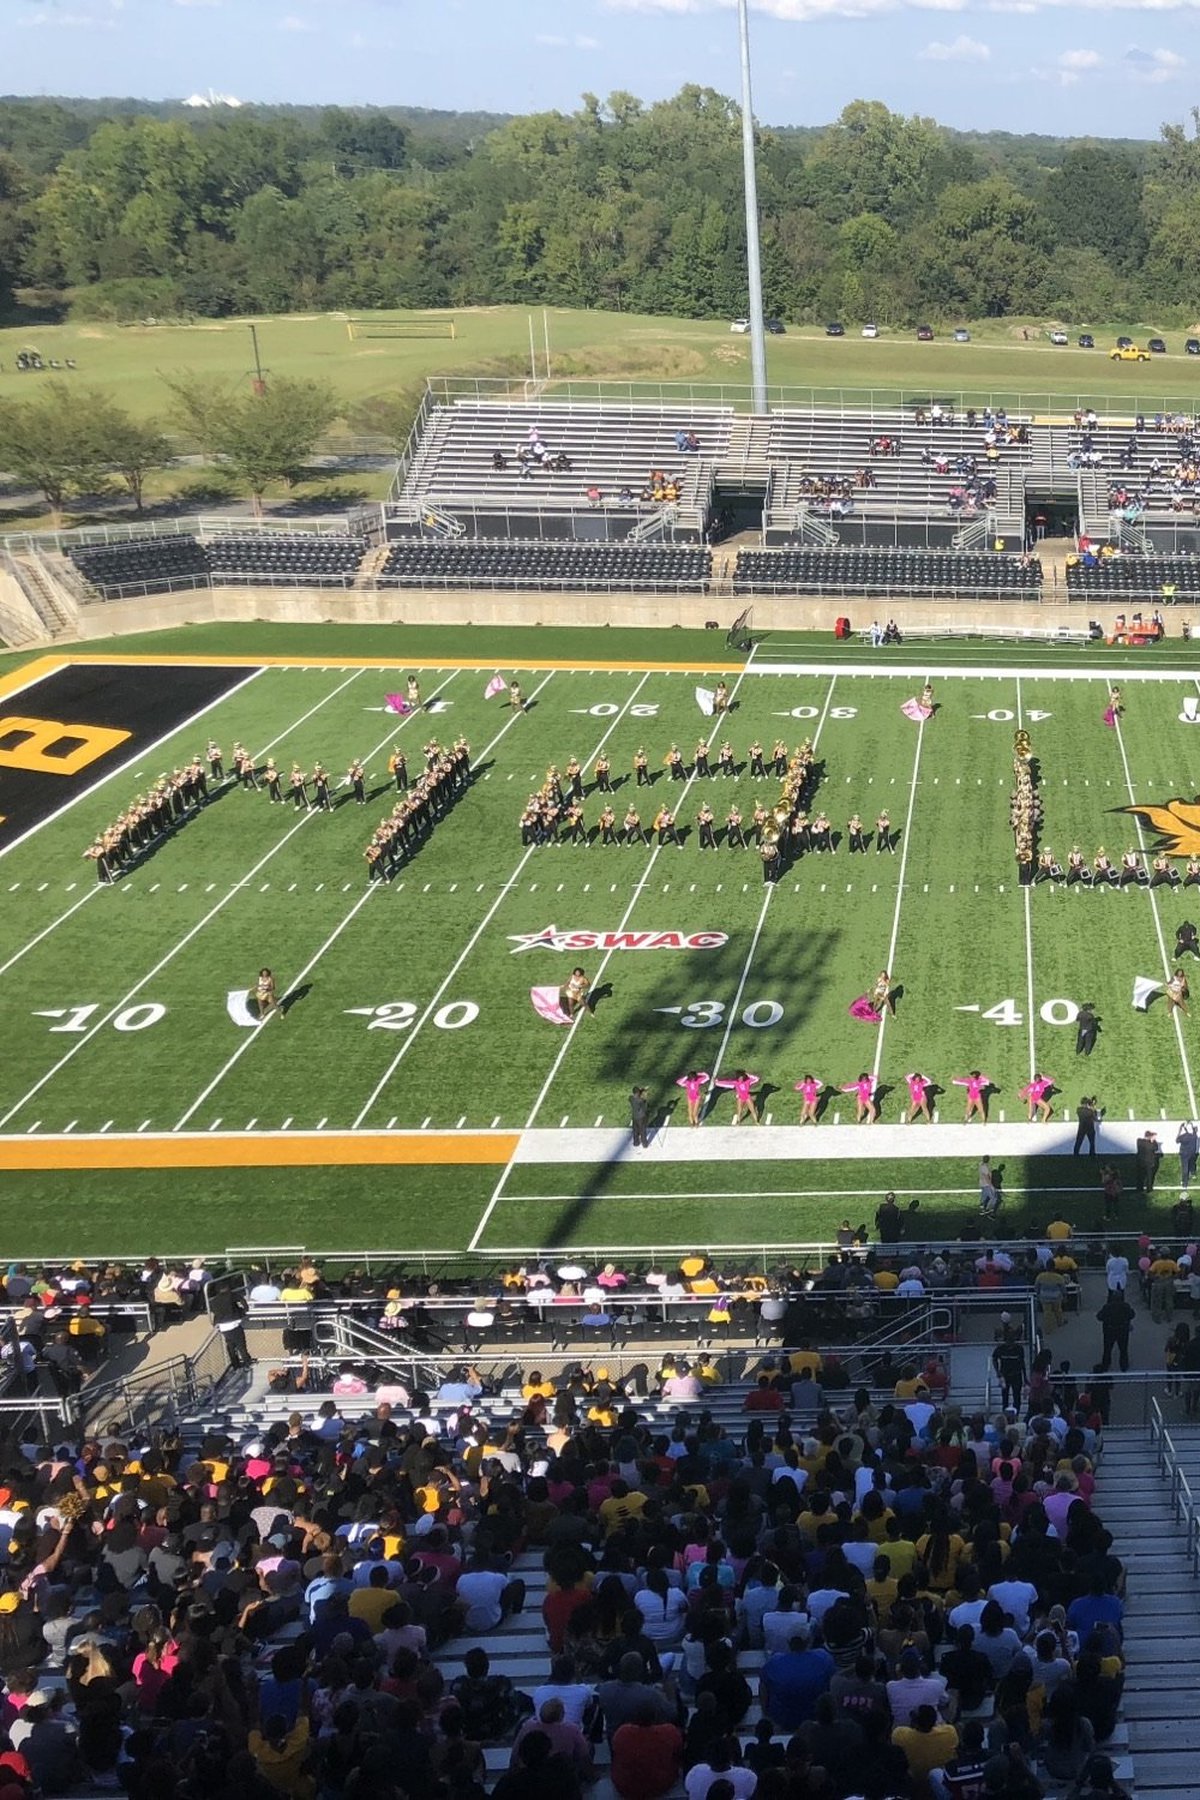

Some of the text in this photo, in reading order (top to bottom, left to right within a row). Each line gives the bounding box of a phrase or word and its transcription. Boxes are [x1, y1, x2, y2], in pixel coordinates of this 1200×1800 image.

[589, 703, 660, 716] 20
[791, 706, 859, 719] 30
[986, 709, 1053, 722] 40
[560, 930, 729, 950] SWAC
[48, 1003, 167, 1032] 10
[367, 1001, 480, 1030] 20
[680, 1000, 785, 1028] 30
[981, 998, 1081, 1025] 40
